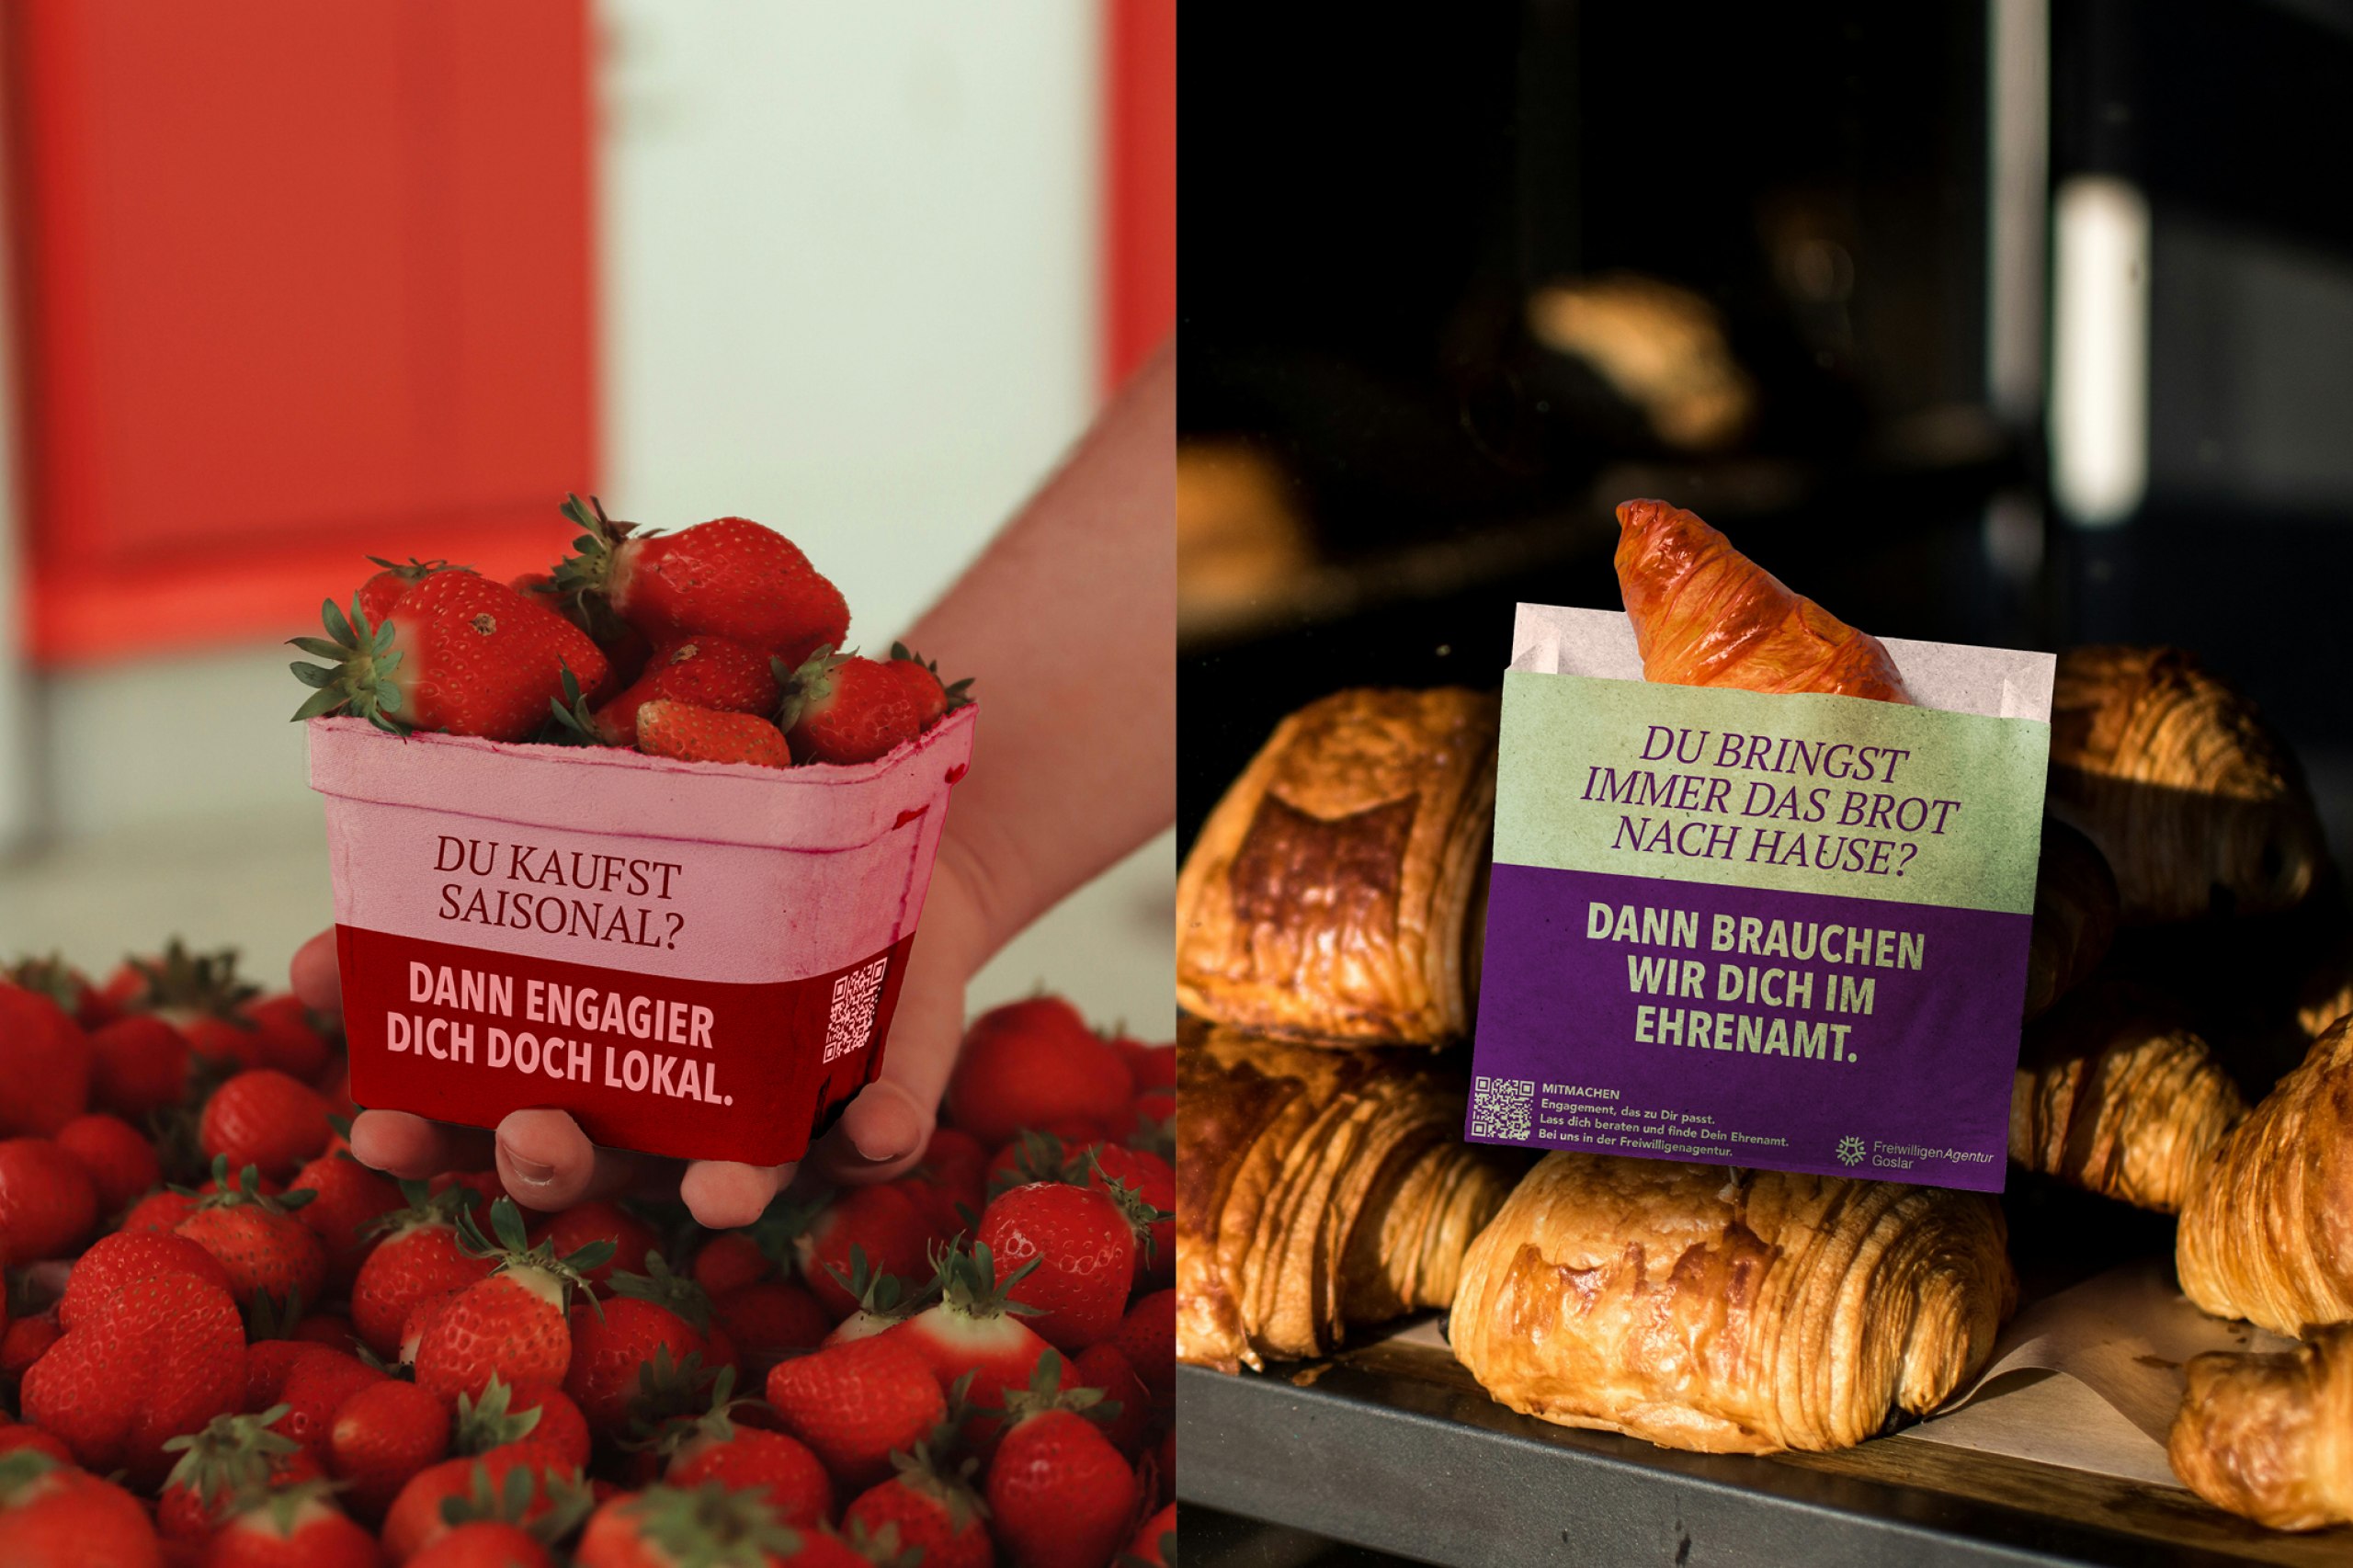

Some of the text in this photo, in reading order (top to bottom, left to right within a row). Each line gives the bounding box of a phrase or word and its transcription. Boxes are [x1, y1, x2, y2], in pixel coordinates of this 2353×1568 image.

[1639, 725, 1910, 784] DU BRINGST
[1580, 766, 1961, 835] IMMER DAS BROT
[434, 835, 683, 901] DU KAUFST
[1611, 815, 1918, 877] NACH HAUSE?
[438, 883, 686, 950] SAISONAL?
[1586, 902, 1925, 971] DANN BRAUCHEN
[408, 960, 715, 1049] DANN ENGAGIER
[1627, 955, 1876, 1016] WIR DICH IM
[386, 1011, 733, 1107] DICH DOCH LOKAL.
[1635, 1006, 1859, 1063] EHRENAMT.
[1540, 1098, 1715, 1125] Engagement, das zu Dir passt.
[1541, 1083, 1620, 1099] MITMACHEN
[1538, 1128, 1733, 1156] Bei uns in der Freiwilligenagentur.
[1540, 1113, 1789, 1146] Lass dich beraten und finde Dein Ehrenamt.
[1873, 1141, 1995, 1163] FreiwilligenAgentur
[1871, 1154, 1915, 1169] Goslar
